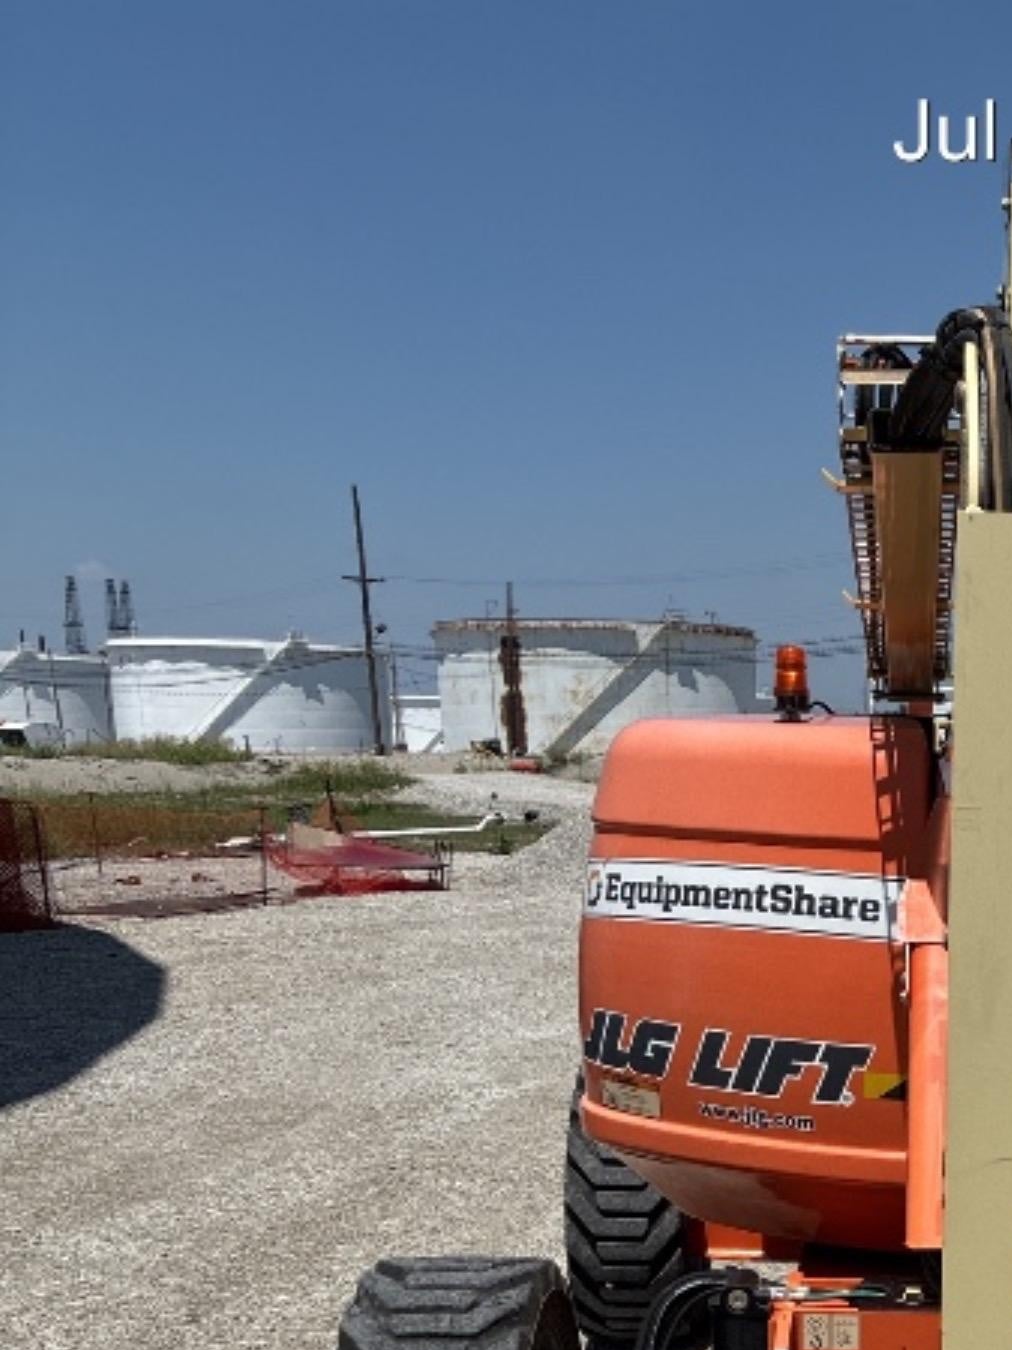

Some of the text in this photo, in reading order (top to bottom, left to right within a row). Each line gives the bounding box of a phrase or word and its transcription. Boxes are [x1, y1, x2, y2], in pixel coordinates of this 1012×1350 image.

[605, 872, 881, 922] EquipmentShare
[585, 1009, 876, 1104] JLG LIFT
[699, 1103, 816, 1132] www.jlg.com
